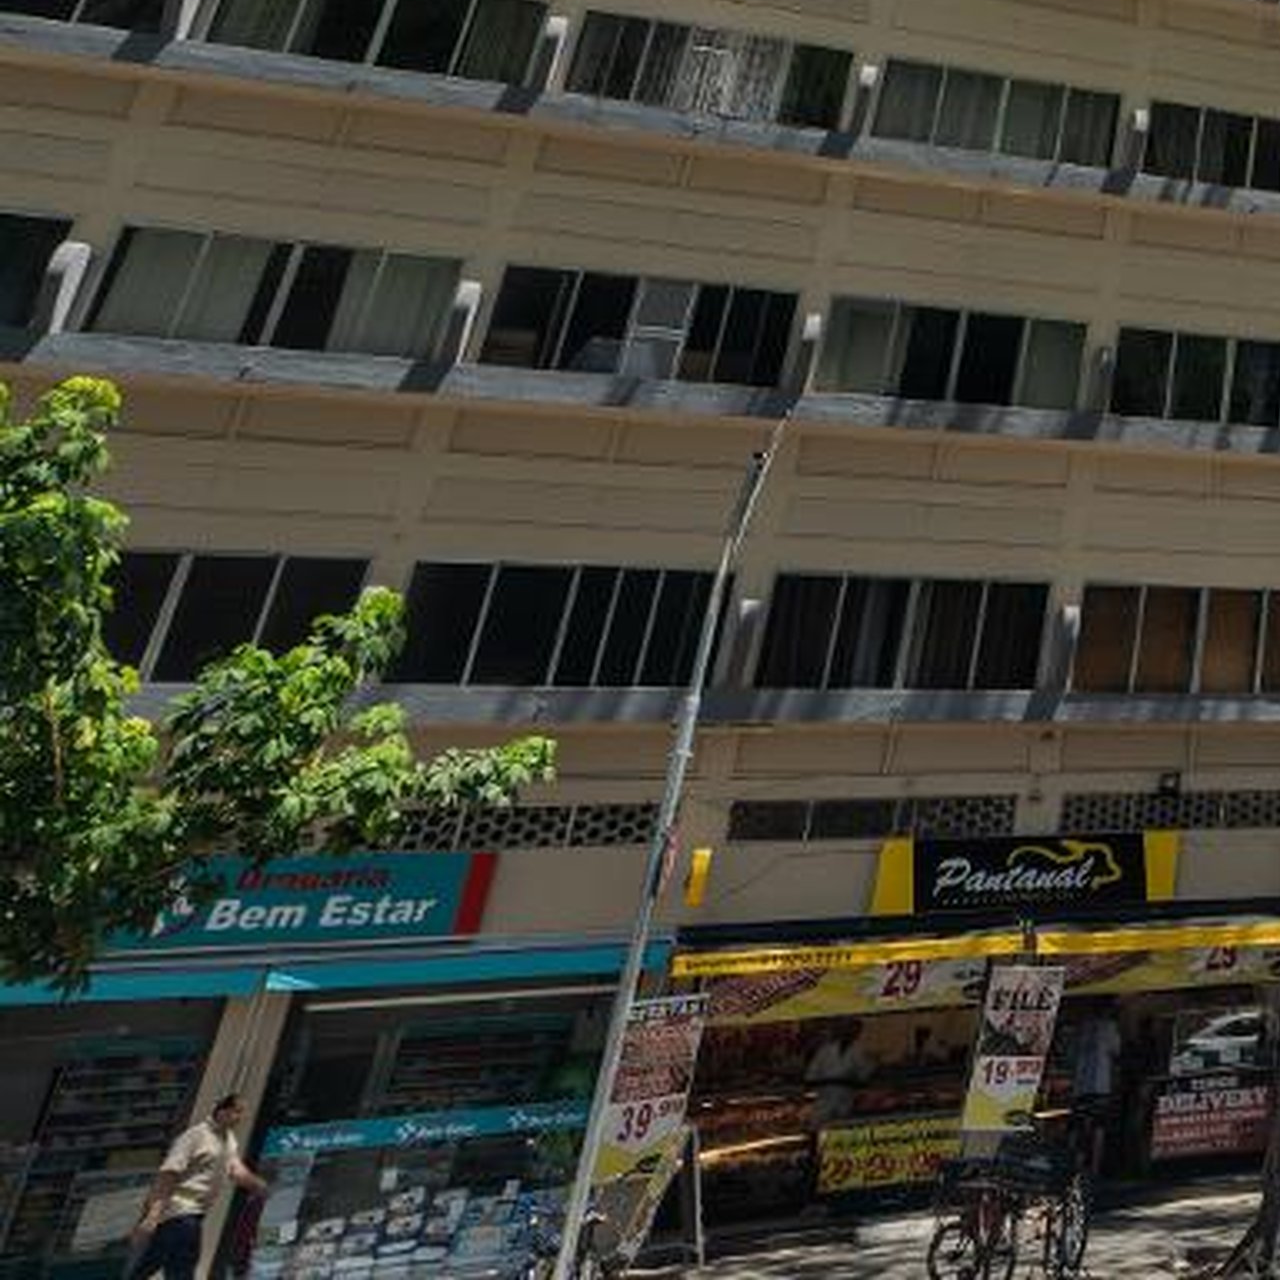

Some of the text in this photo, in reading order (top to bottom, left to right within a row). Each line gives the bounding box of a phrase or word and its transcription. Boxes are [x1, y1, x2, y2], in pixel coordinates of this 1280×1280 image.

[932, 855, 1096, 897] Pantanal
[204, 893, 439, 932] Bem Estar
[1154, 1086, 1268, 1115] DELIVERY
